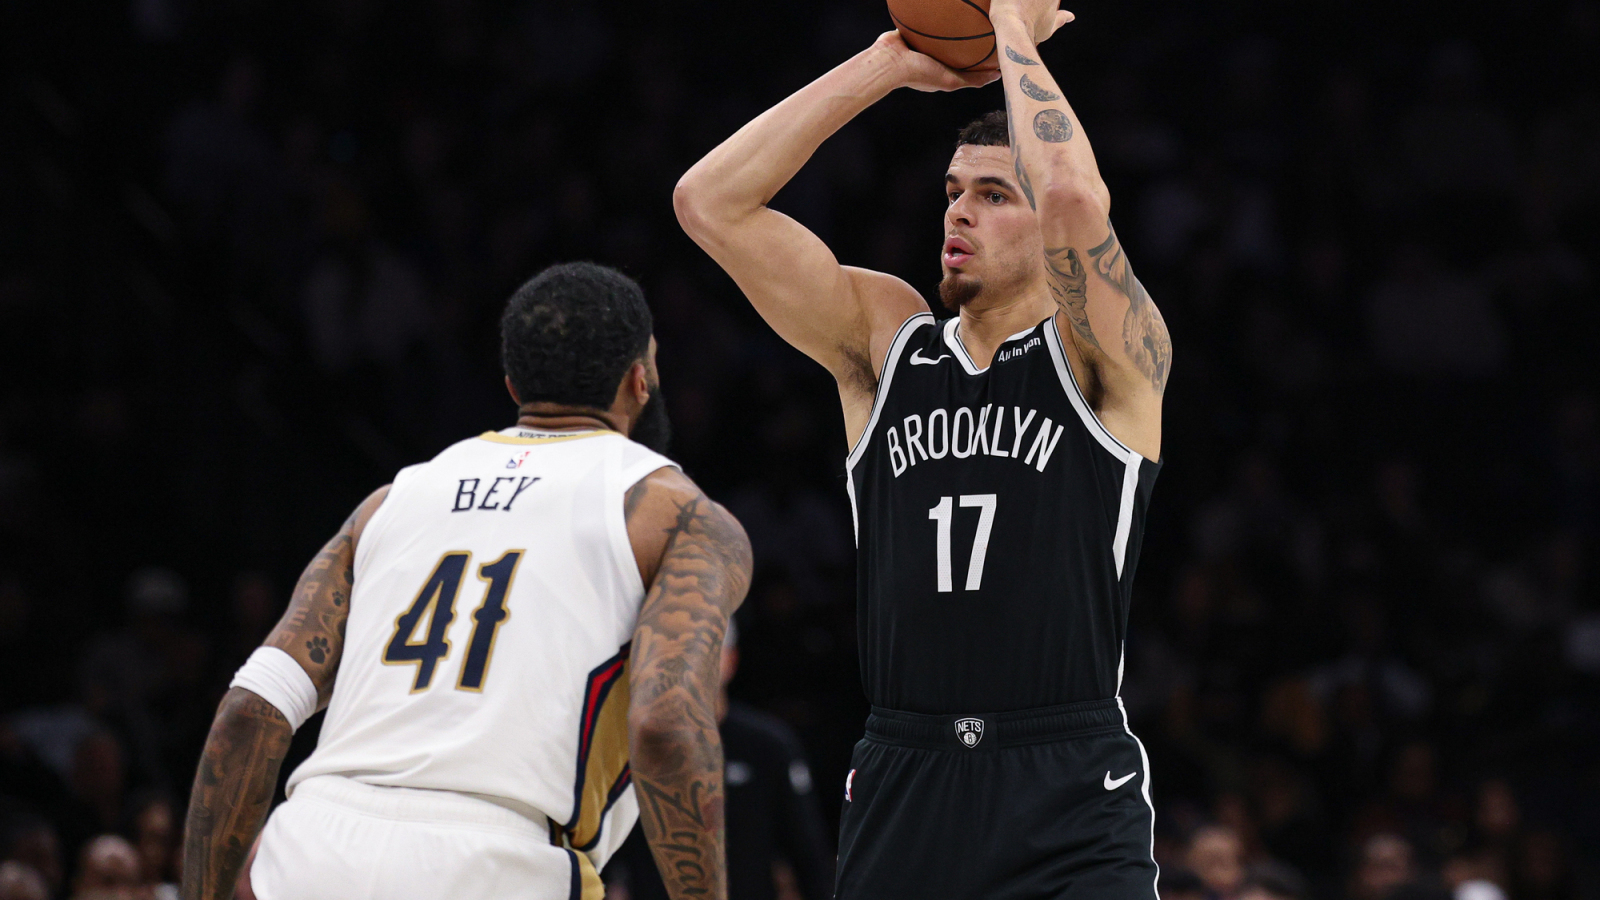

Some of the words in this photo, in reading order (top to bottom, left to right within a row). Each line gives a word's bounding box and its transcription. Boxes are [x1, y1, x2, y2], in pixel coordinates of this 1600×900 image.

[887, 403, 1065, 478] BROOKLYN
[451, 476, 541, 512] BEY
[928, 493, 998, 593] 17
[381, 549, 527, 695] 41
[957, 721, 981, 733] NETS
